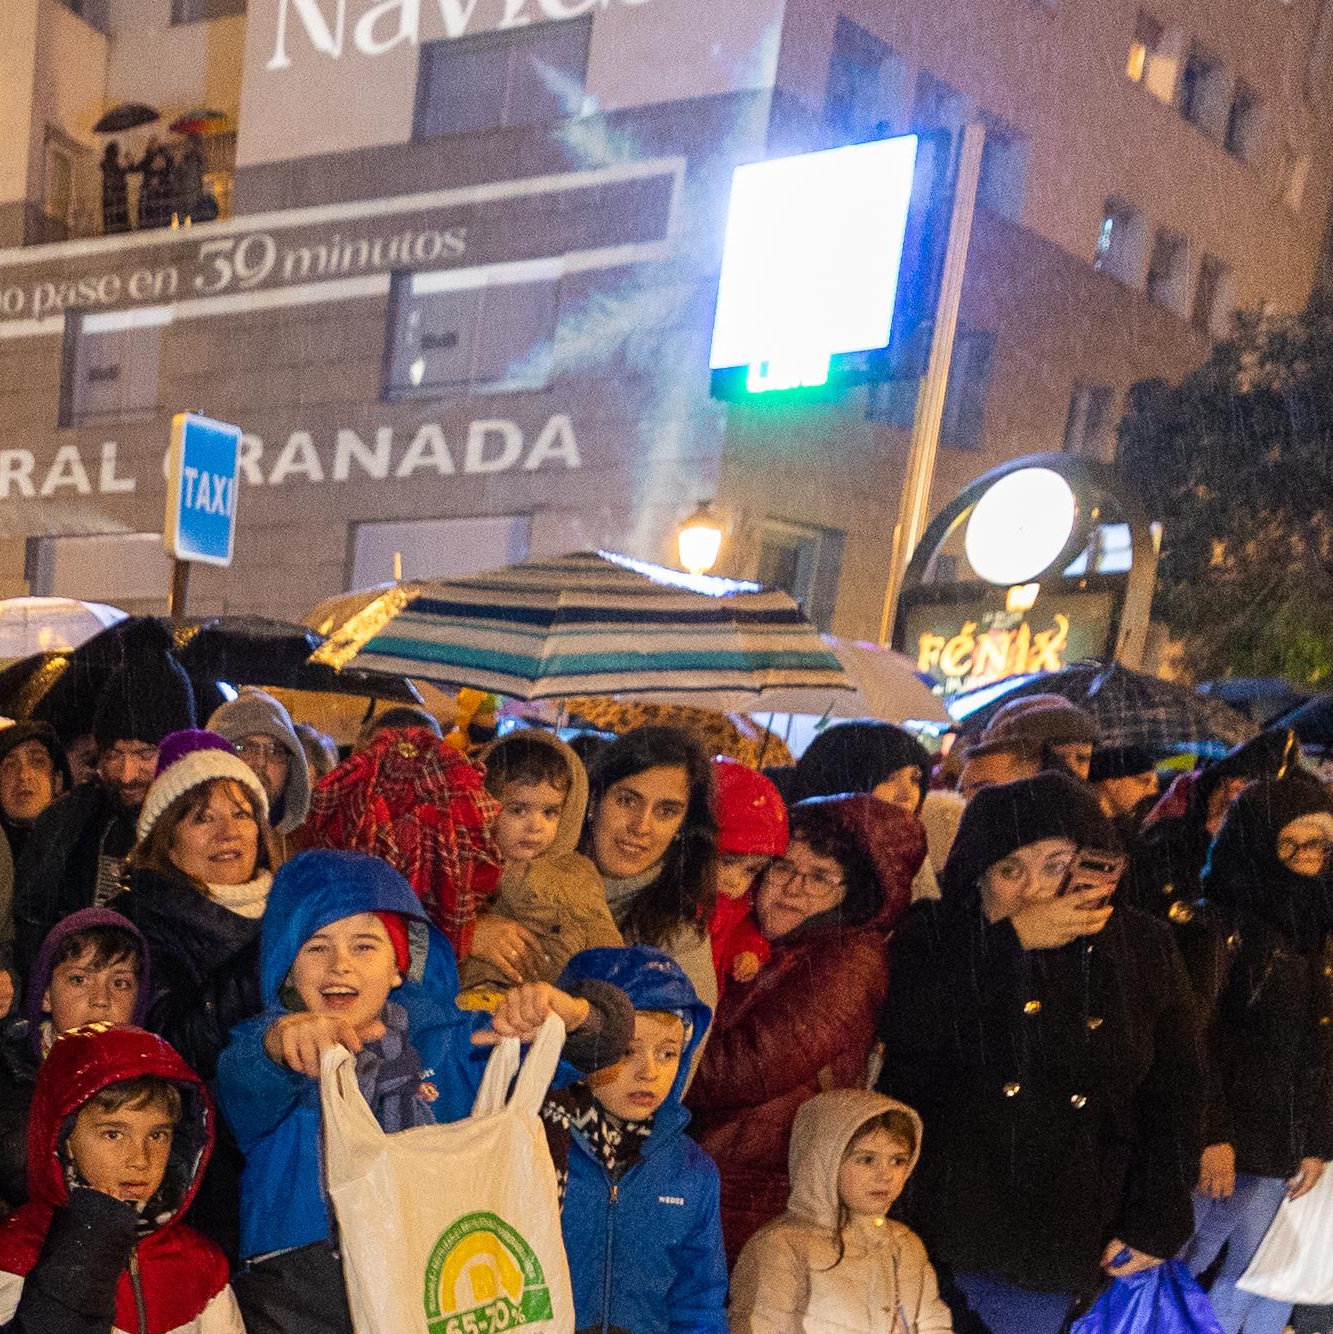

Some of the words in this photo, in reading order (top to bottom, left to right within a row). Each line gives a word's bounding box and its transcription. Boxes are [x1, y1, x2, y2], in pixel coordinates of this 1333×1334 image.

[33, 271, 121, 320] pase
[128, 266, 178, 299] en
[284, 228, 467, 278] minutos
[162, 413, 581, 486] RANADA
[184, 465, 233, 516] TAXI
